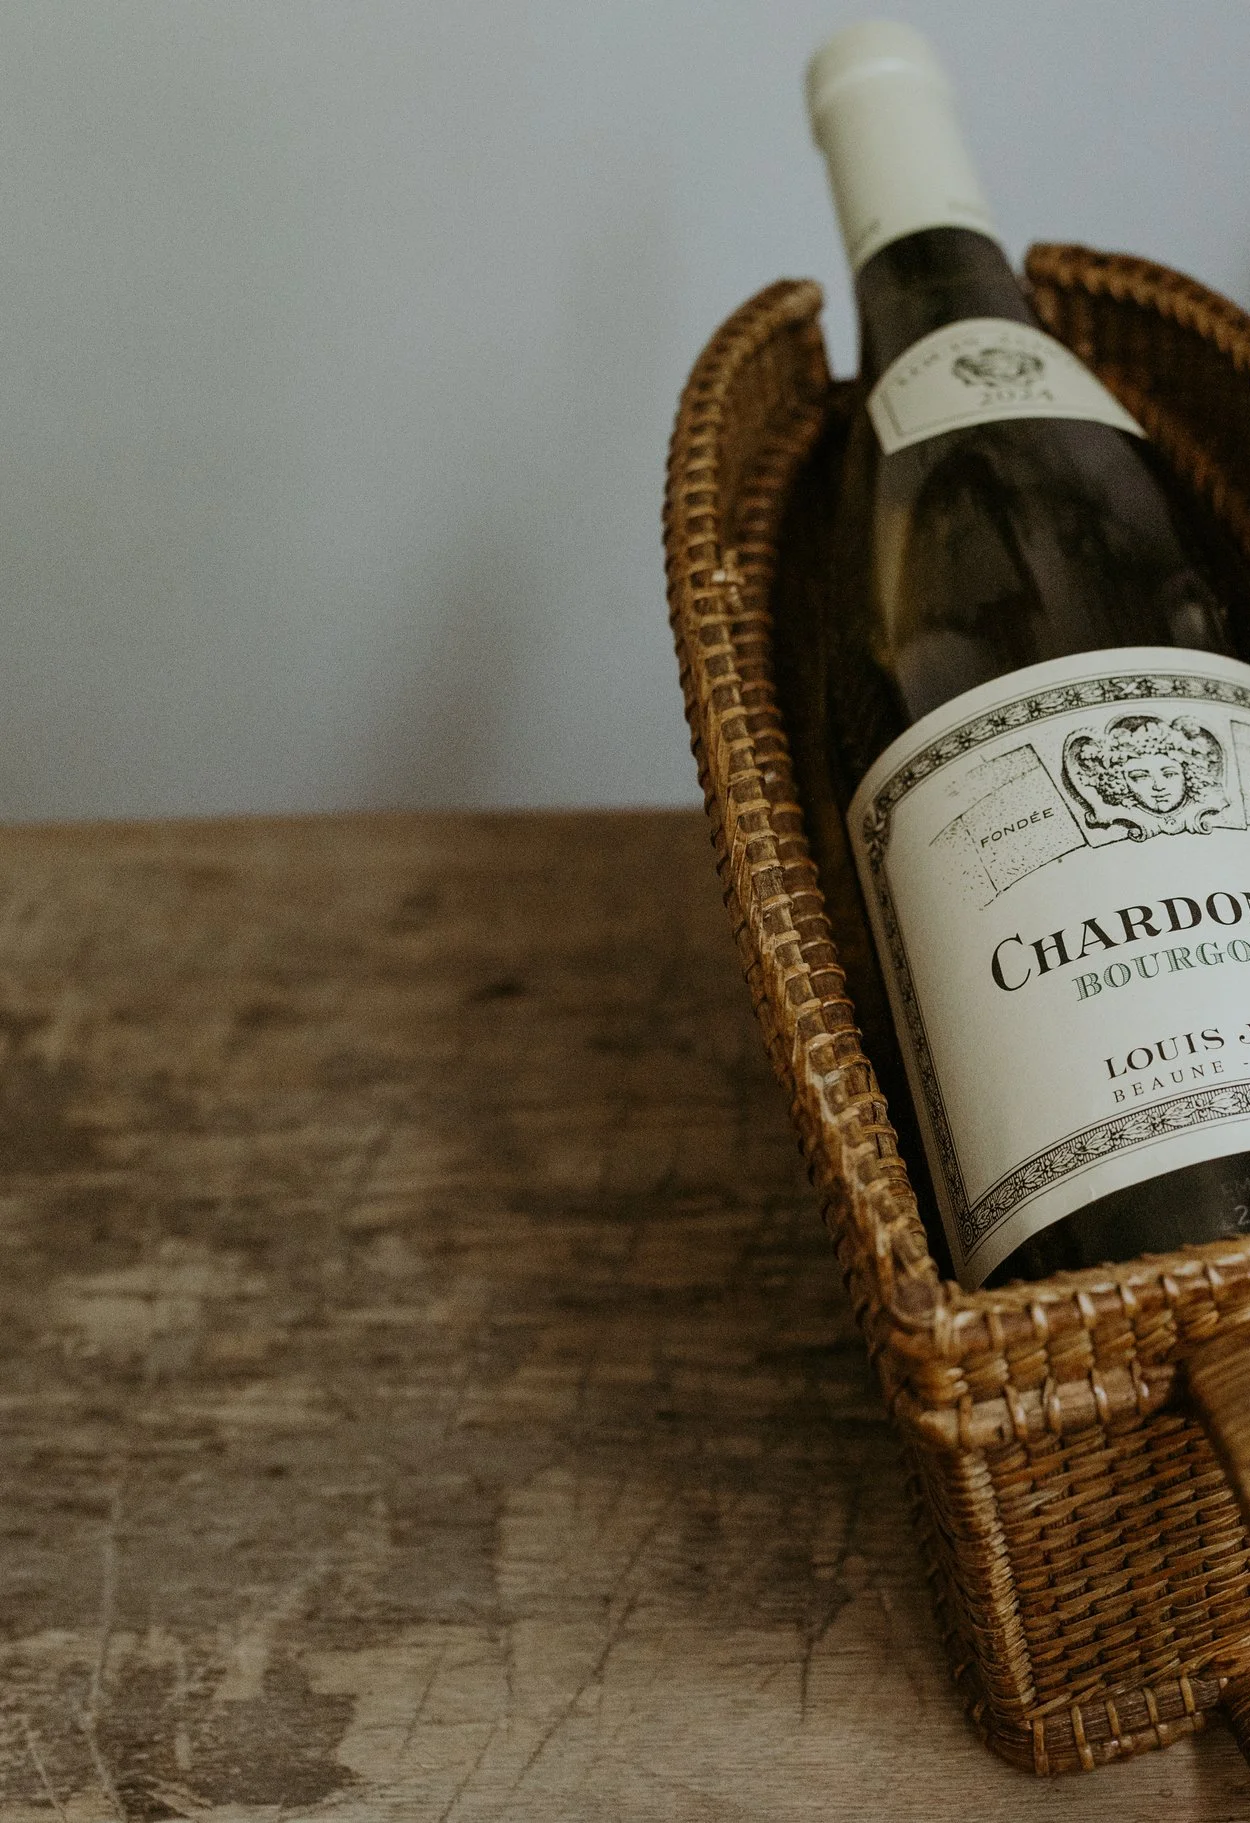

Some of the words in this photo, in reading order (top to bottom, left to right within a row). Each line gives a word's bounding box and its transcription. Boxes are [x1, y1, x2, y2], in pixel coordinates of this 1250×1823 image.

[980, 807, 1055, 848] FONDÉE
[1103, 1028, 1226, 1080] LOUIS
[1113, 1060, 1225, 1103] BEAUNE
